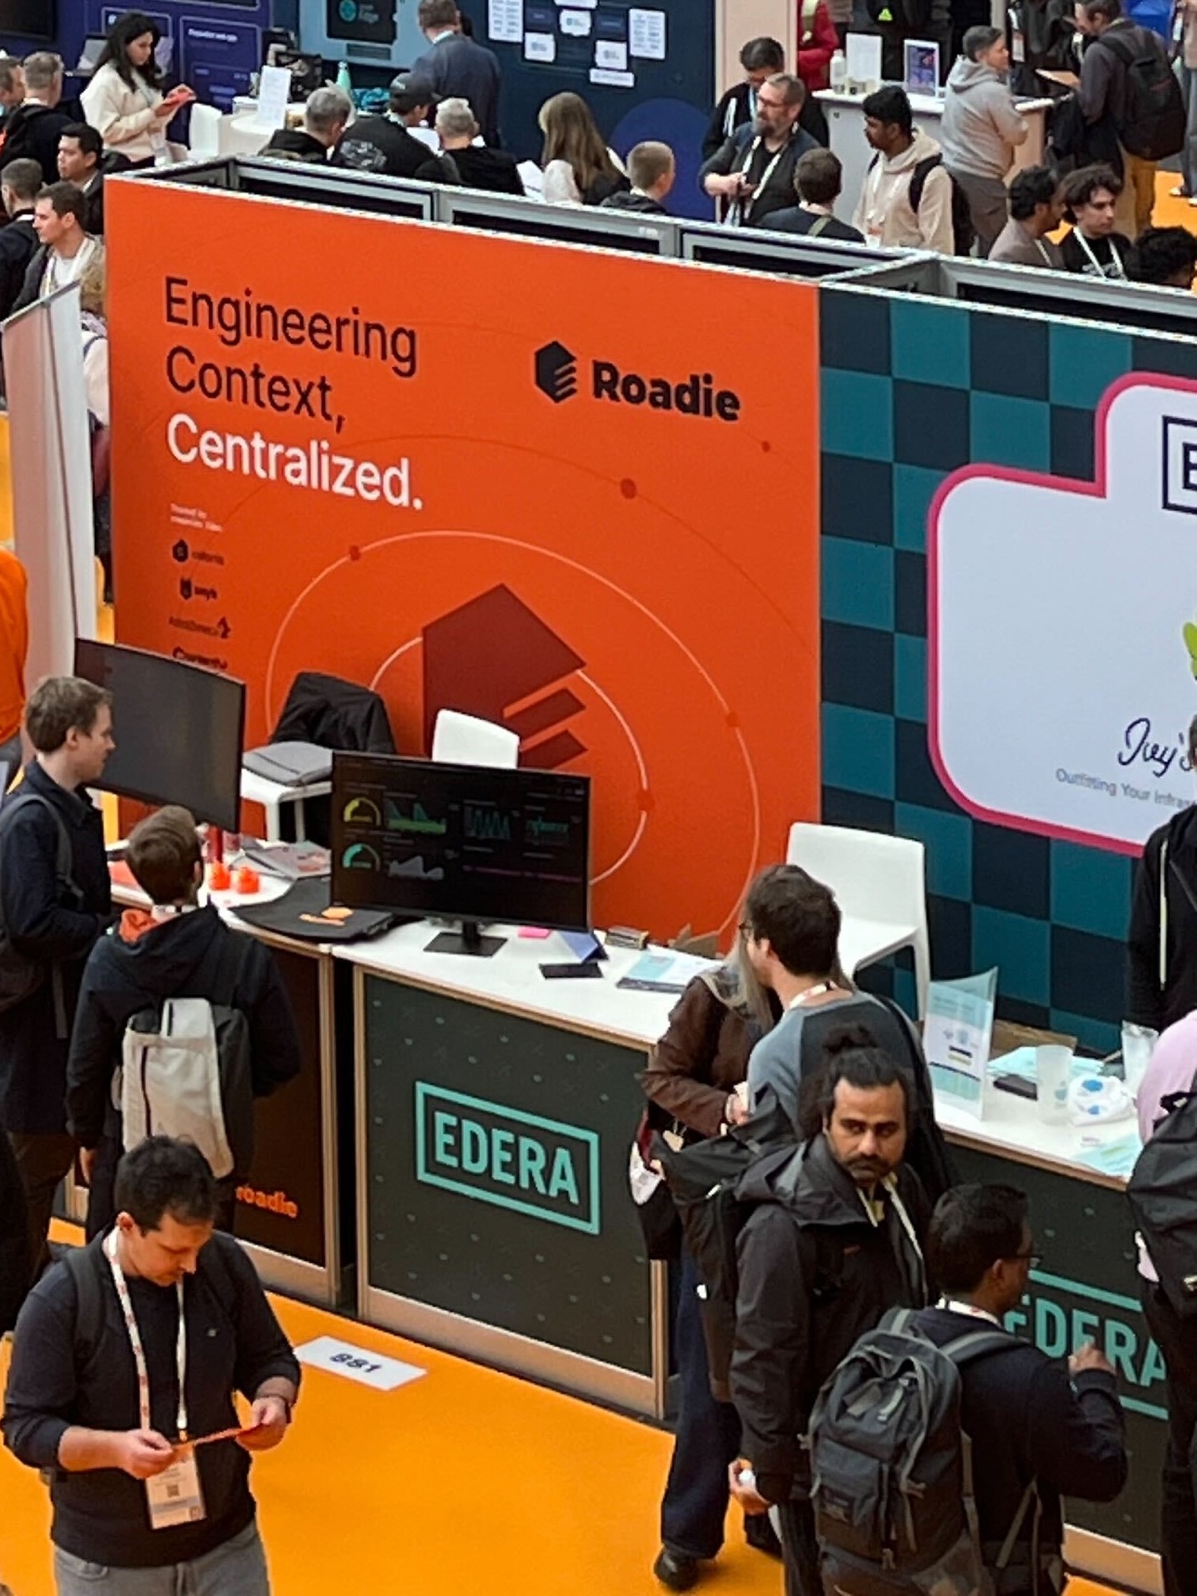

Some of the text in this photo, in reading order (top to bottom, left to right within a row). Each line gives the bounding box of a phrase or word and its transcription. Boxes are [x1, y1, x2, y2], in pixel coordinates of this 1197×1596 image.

[164, 275, 418, 378] Engineering
[166, 345, 347, 434] Context,
[591, 359, 742, 422] Roadie
[168, 413, 424, 510] Centralized.
[1121, 783, 1151, 801] Your
[434, 1109, 580, 1205] EDERA
